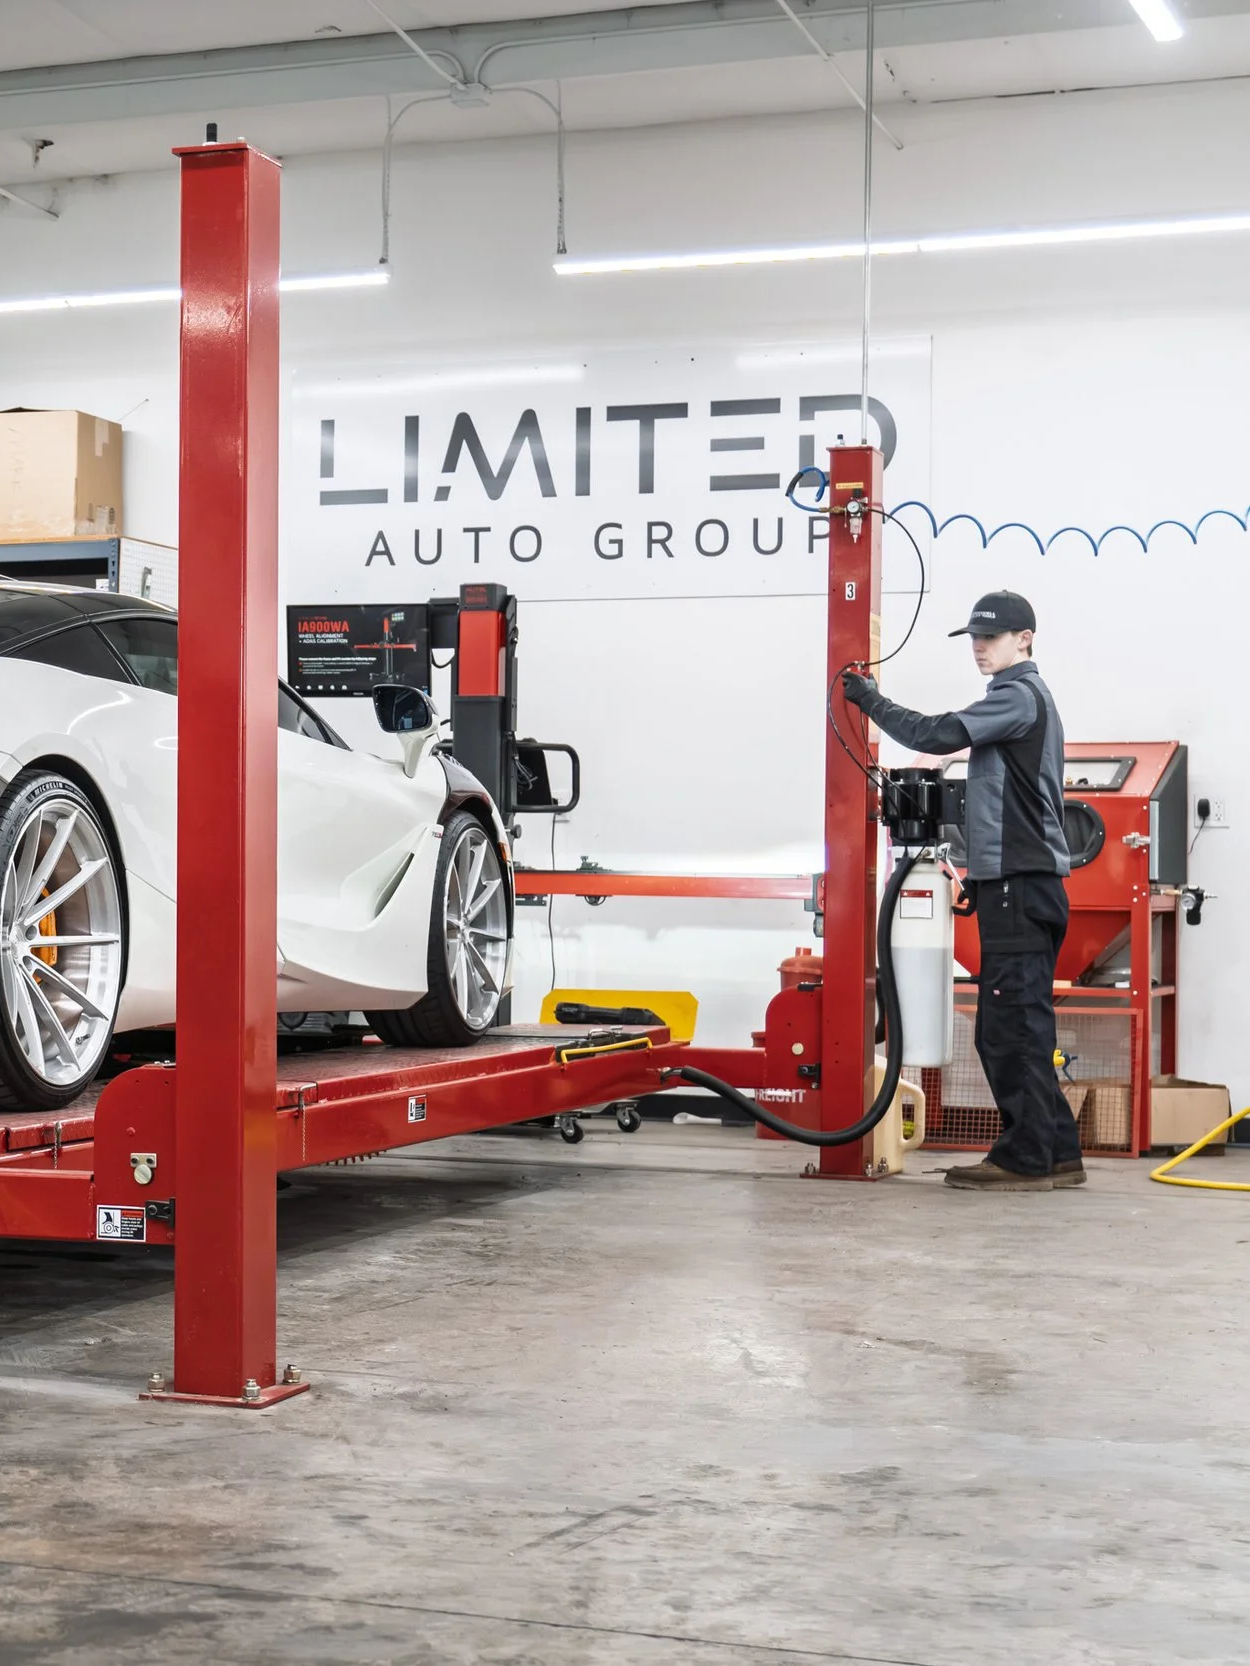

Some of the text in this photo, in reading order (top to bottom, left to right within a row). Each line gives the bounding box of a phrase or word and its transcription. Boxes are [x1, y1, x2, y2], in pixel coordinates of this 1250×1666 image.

[319, 394, 897, 505] LIMITED
[365, 517, 830, 567] AUTO GROUP
[846, 583, 854, 599] 3
[298, 621, 349, 632] IA900WA
[34, 781, 63, 795] MICHELIN
